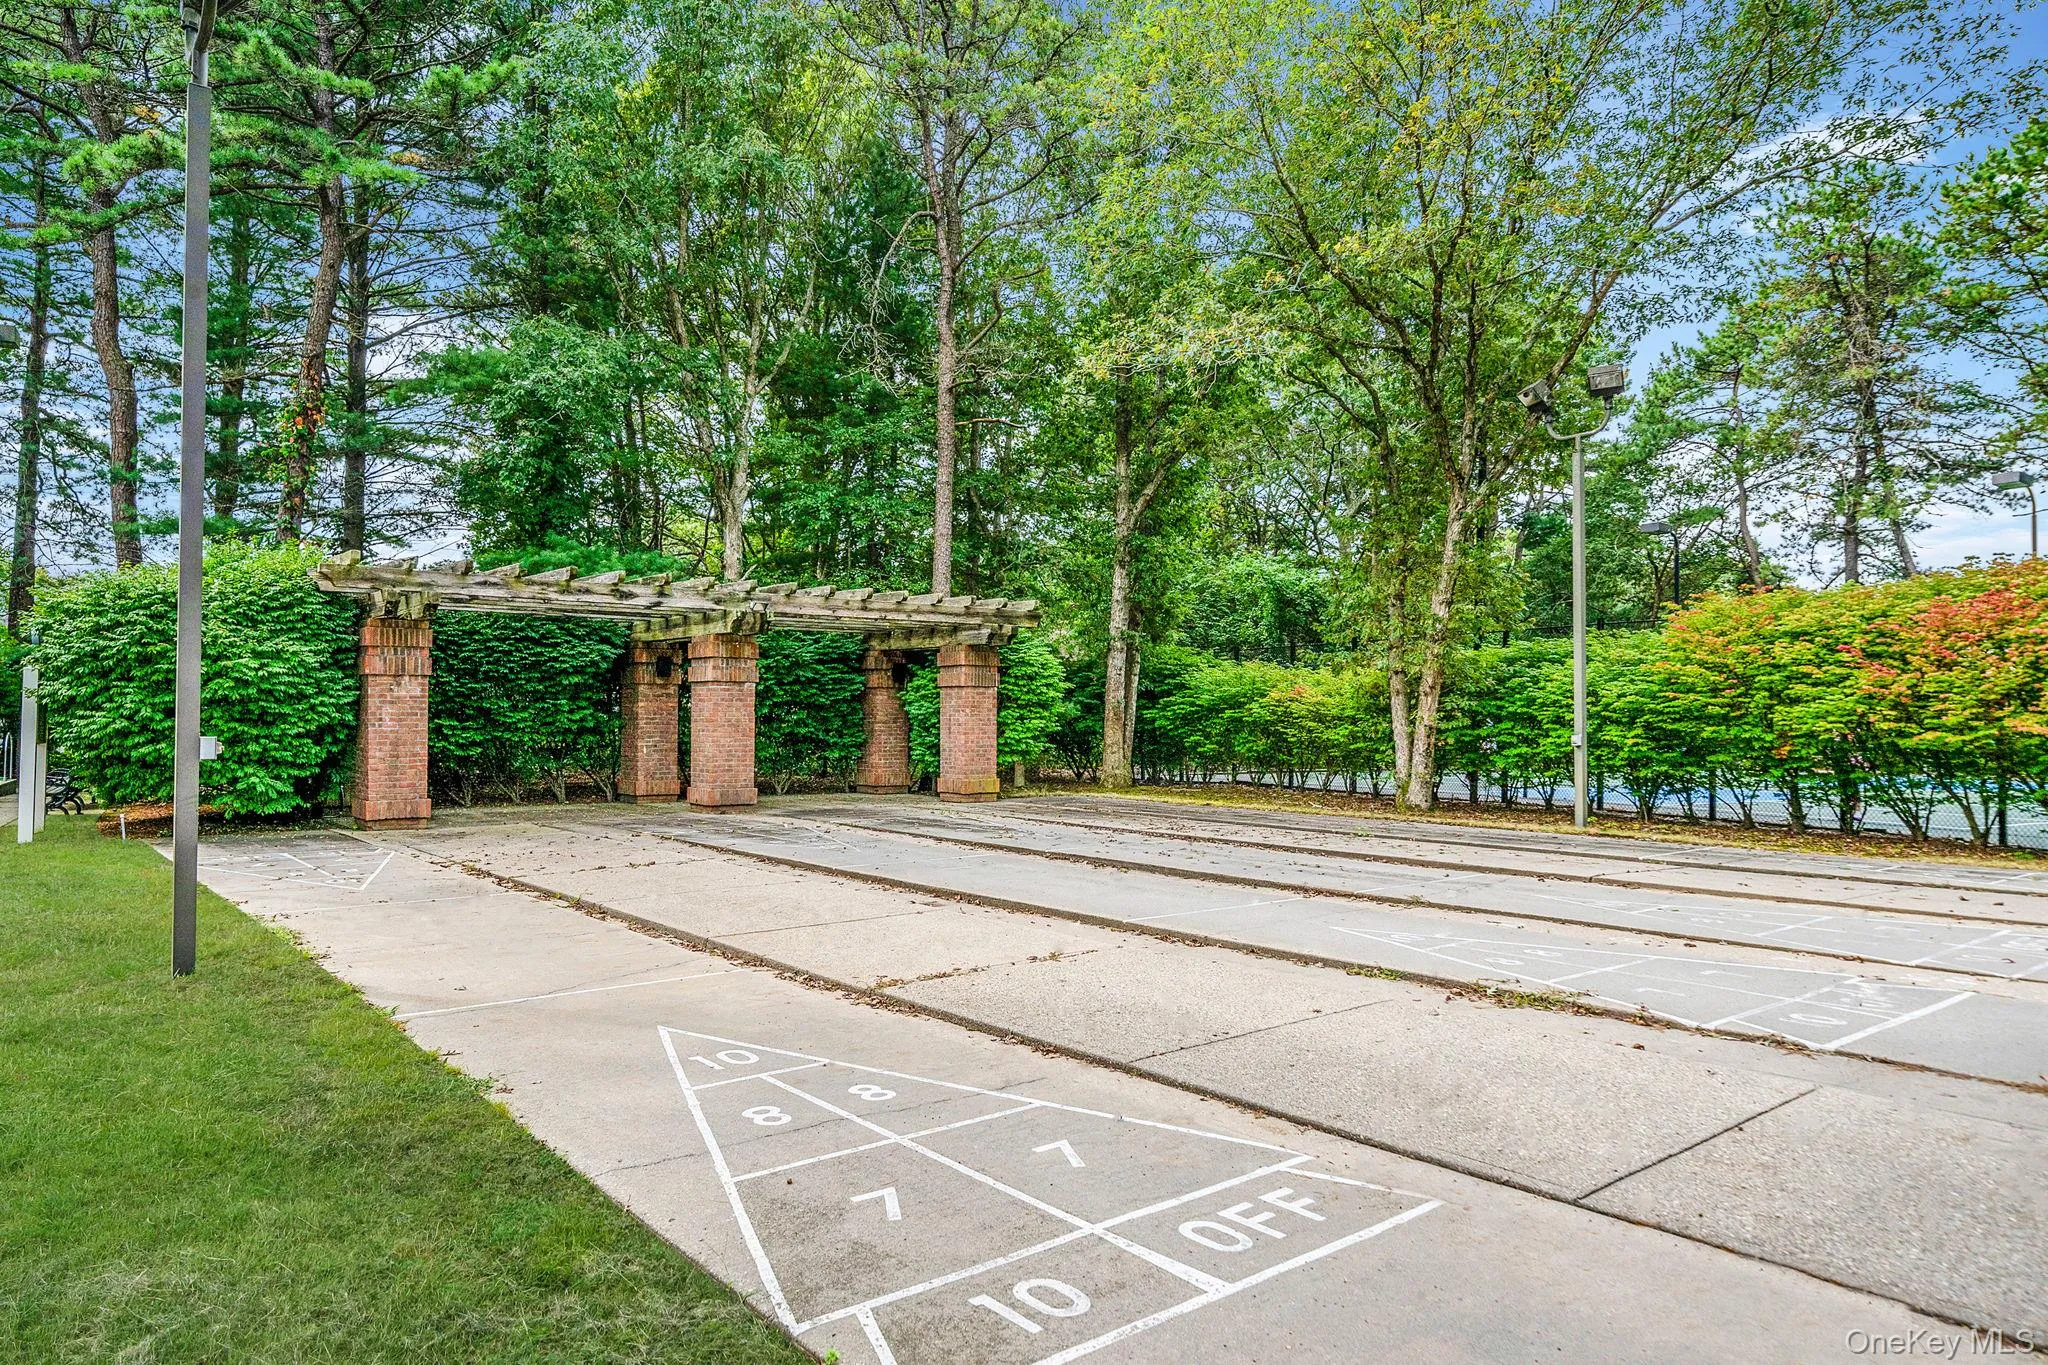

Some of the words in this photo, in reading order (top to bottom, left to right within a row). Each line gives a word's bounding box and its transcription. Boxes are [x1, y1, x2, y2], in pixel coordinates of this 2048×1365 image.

[688, 1050, 760, 1070] 10
[847, 1084, 897, 1101] 8
[741, 1105, 792, 1126] 8
[1031, 1139, 1086, 1168] 7
[850, 1186, 902, 1221] 7
[1178, 1187, 1326, 1253] OFF
[967, 1278, 1091, 1334] 10
